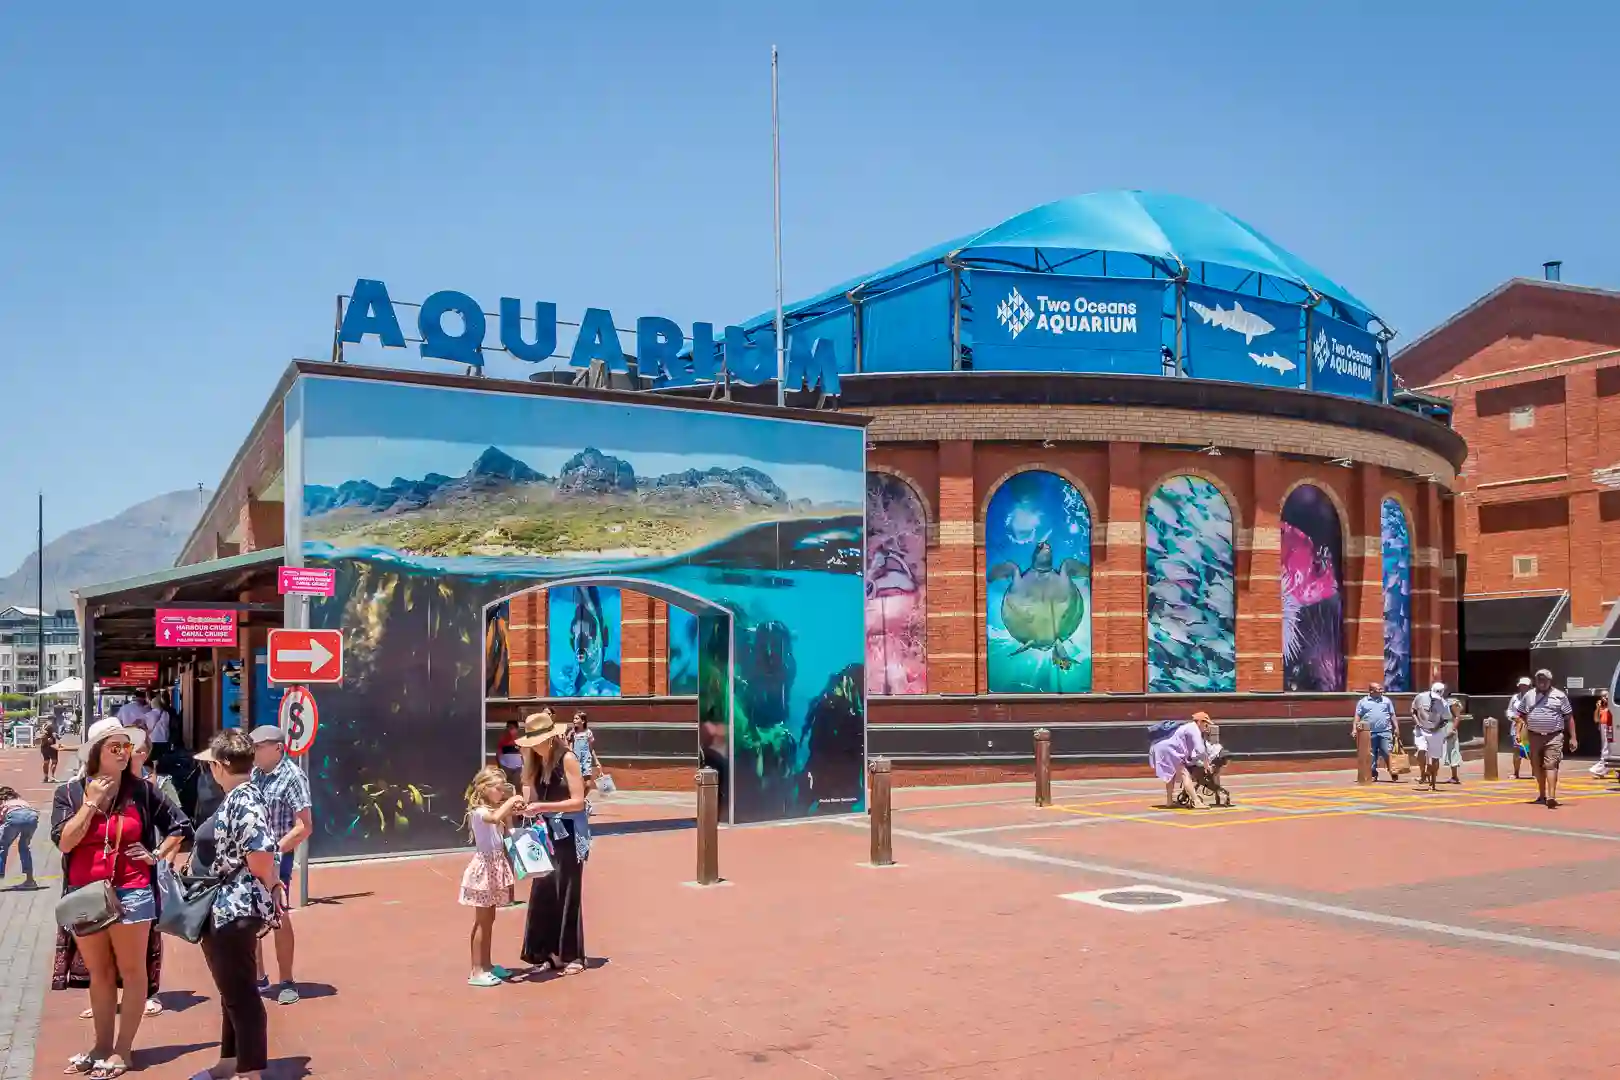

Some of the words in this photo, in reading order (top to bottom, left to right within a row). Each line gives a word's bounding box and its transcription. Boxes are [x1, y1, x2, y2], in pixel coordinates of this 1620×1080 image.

[1036, 295, 1071, 312] Two
[1074, 297, 1137, 315] Oceans
[338, 278, 841, 397] AQUARIUM
[1036, 313, 1137, 334] AQUARIUM
[1331, 337, 1346, 356] Two
[1346, 344, 1373, 366] Oceans
[1329, 354, 1372, 382] AQUARIUM
[288, 702, 305, 741] S
